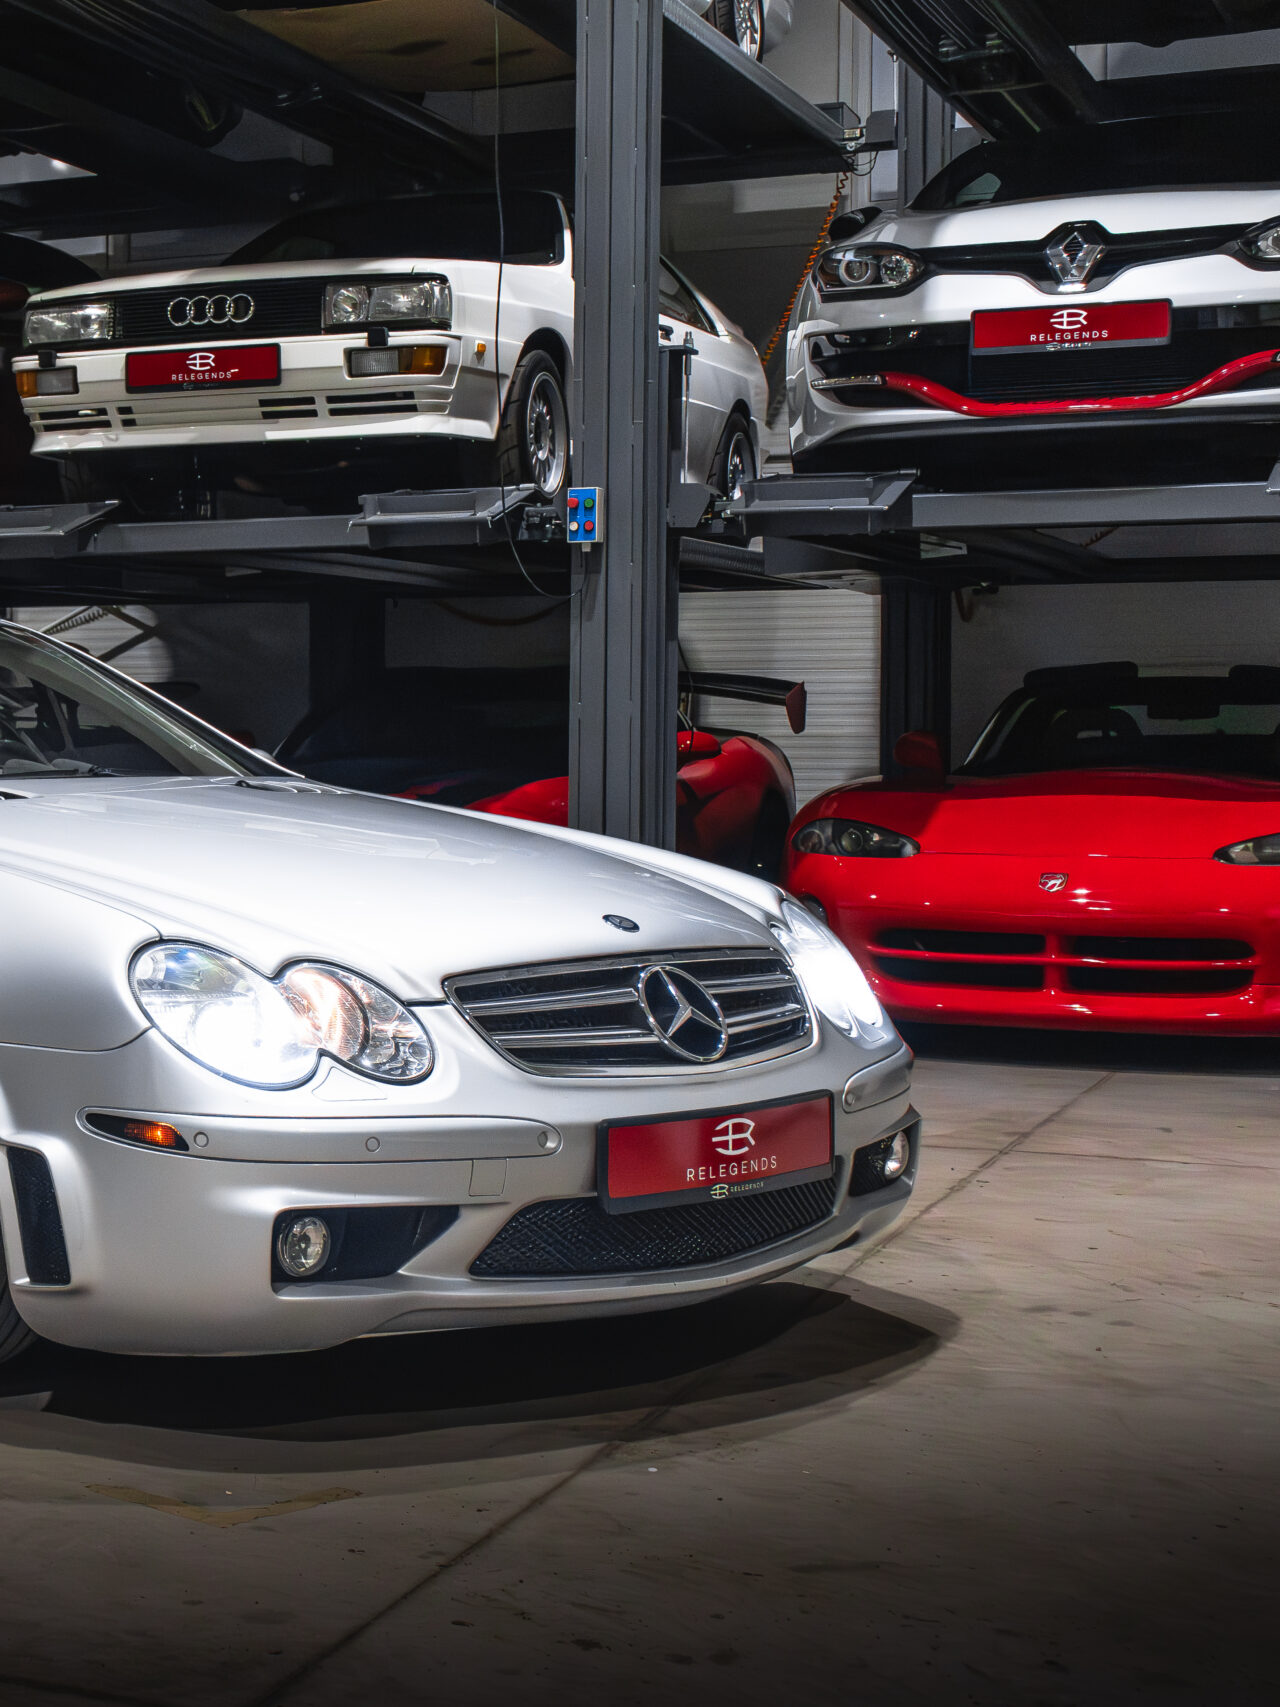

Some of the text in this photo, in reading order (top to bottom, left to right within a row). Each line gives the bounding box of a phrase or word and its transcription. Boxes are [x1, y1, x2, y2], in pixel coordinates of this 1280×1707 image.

[1030, 329, 1109, 342] RELEGENDS
[171, 371, 232, 381] RELEGENDS
[686, 1155, 777, 1182] RELEGENDS
